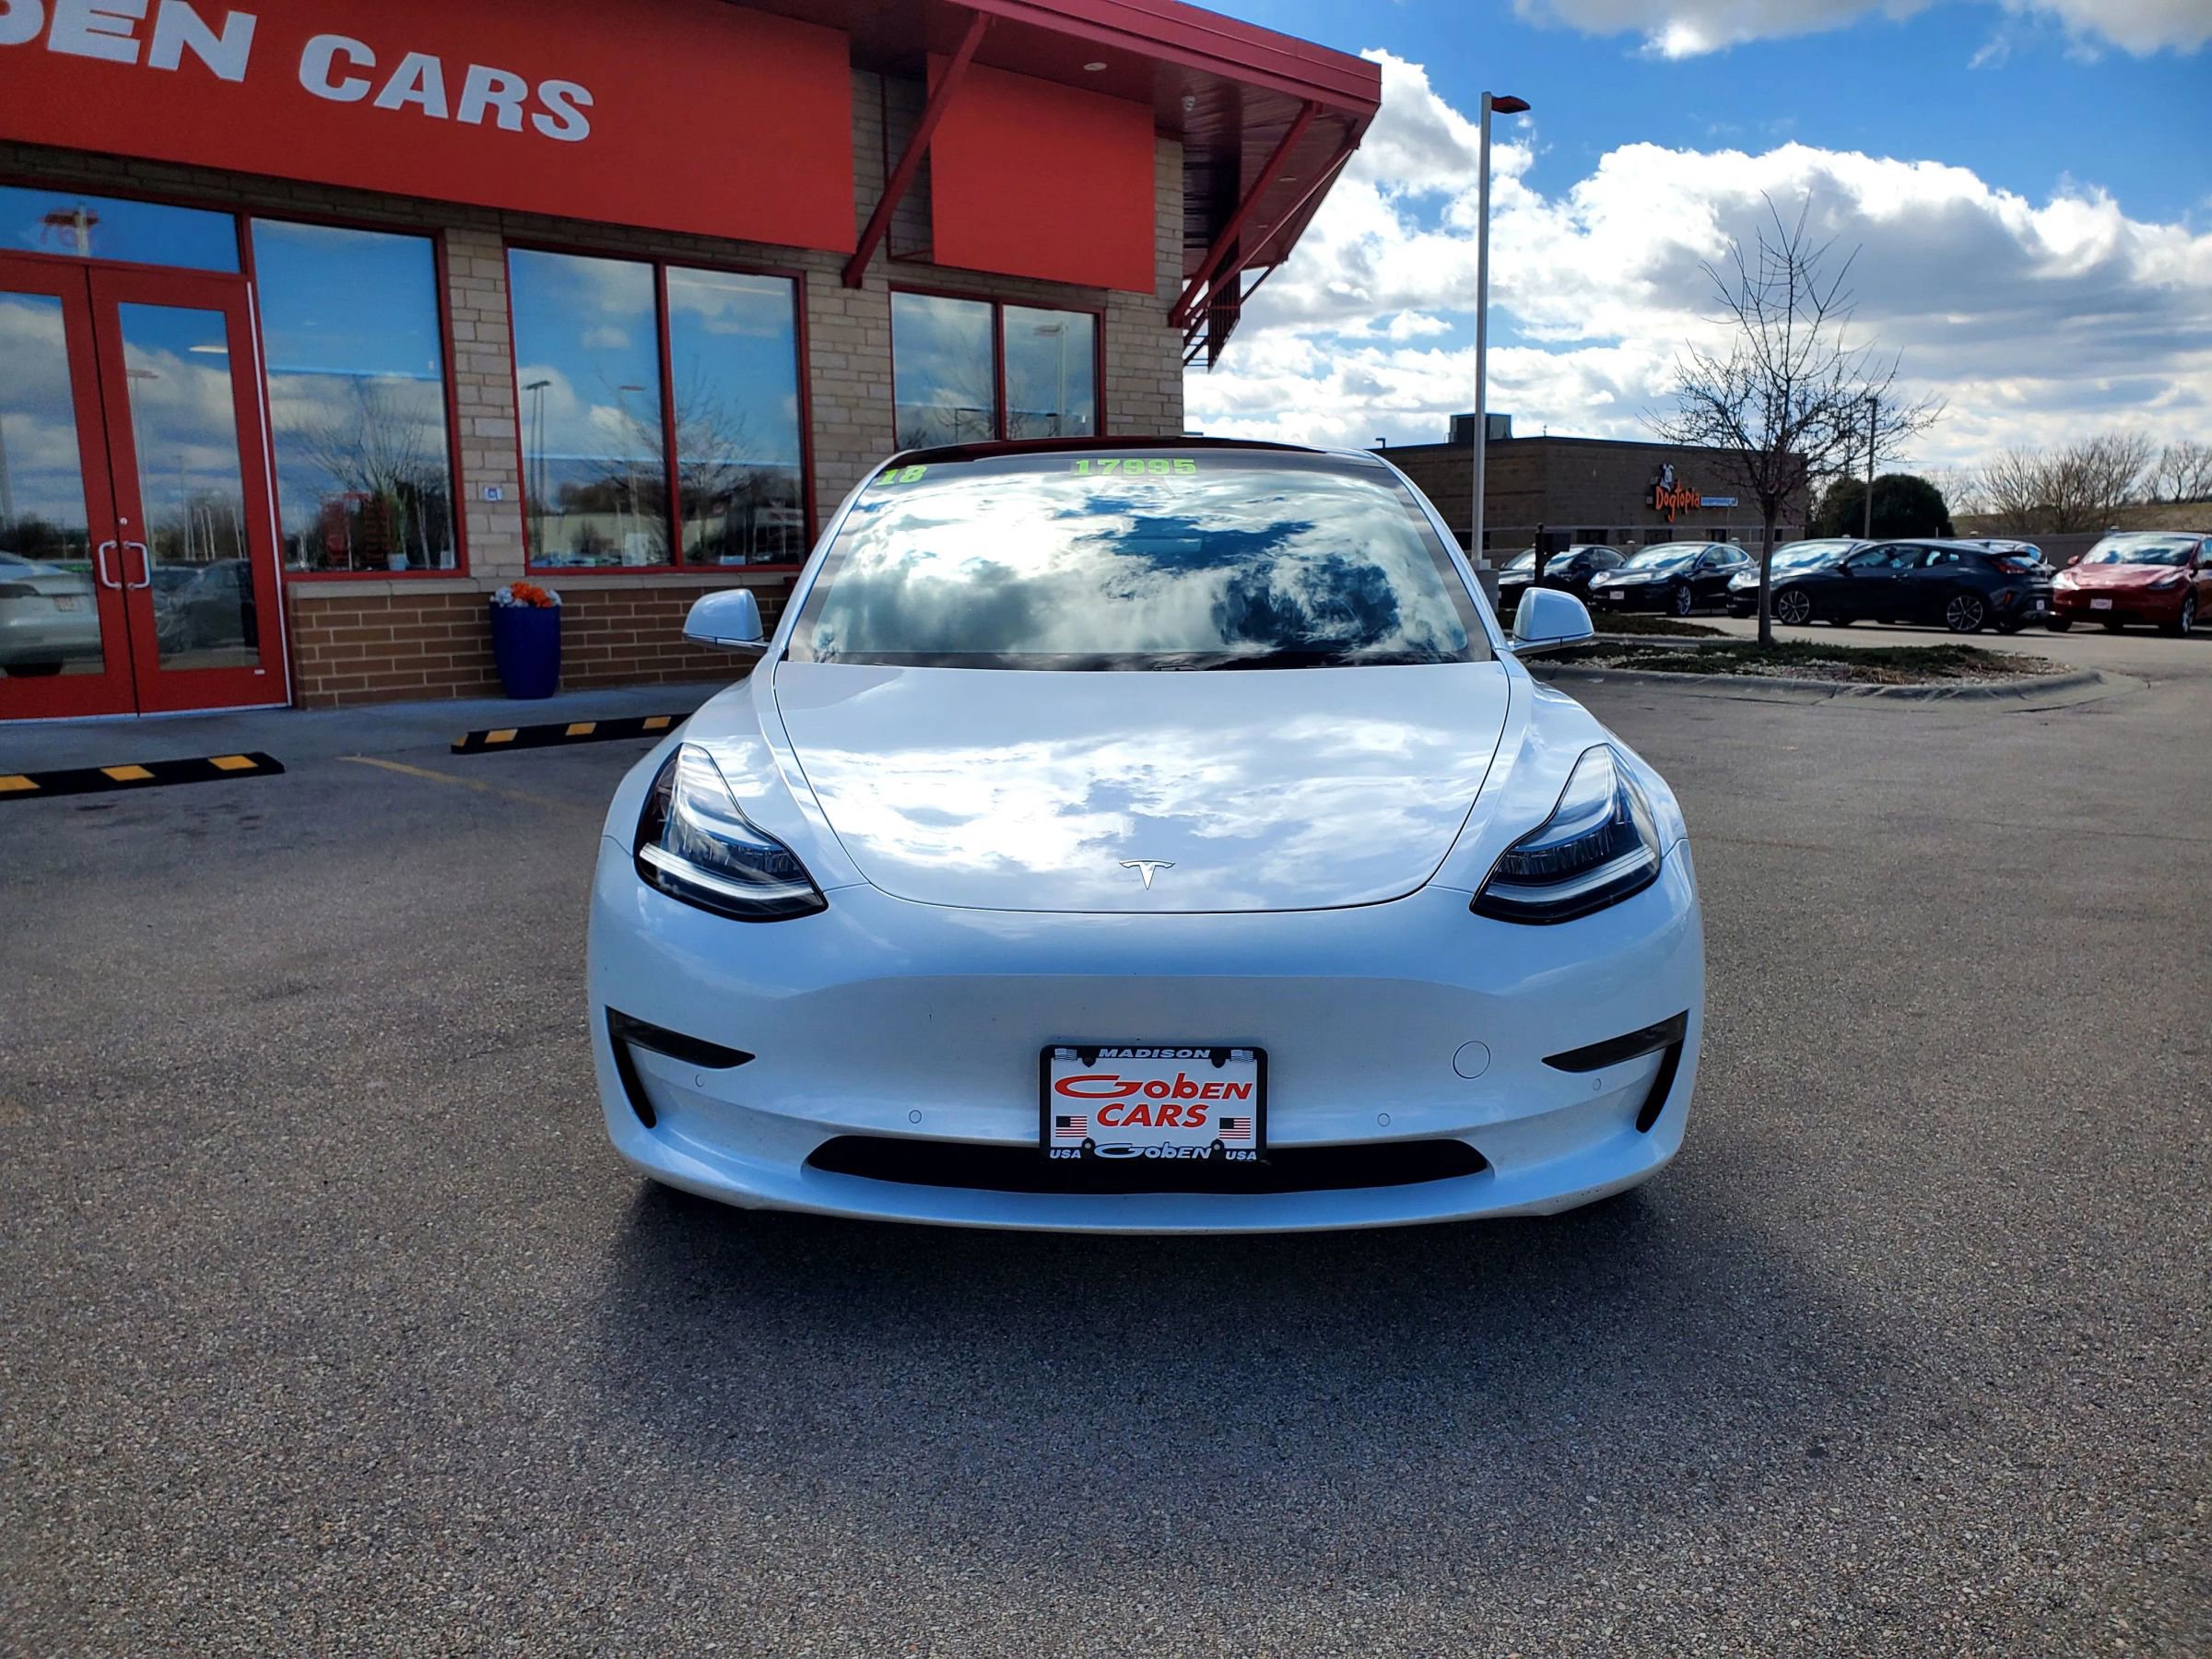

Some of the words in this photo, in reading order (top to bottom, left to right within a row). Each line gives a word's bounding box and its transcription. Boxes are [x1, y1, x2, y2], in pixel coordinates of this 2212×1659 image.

[299, 34, 594, 141] CARS
[877, 466, 927, 486] 18
[1075, 459, 1196, 476] 17995
[1656, 479, 1700, 523] Dogtopia
[1099, 1048, 1210, 1059] MADISON
[1097, 1103, 1209, 1127] CARS
[1049, 1149, 1081, 1159] USA
[1225, 1151, 1257, 1160] USA
